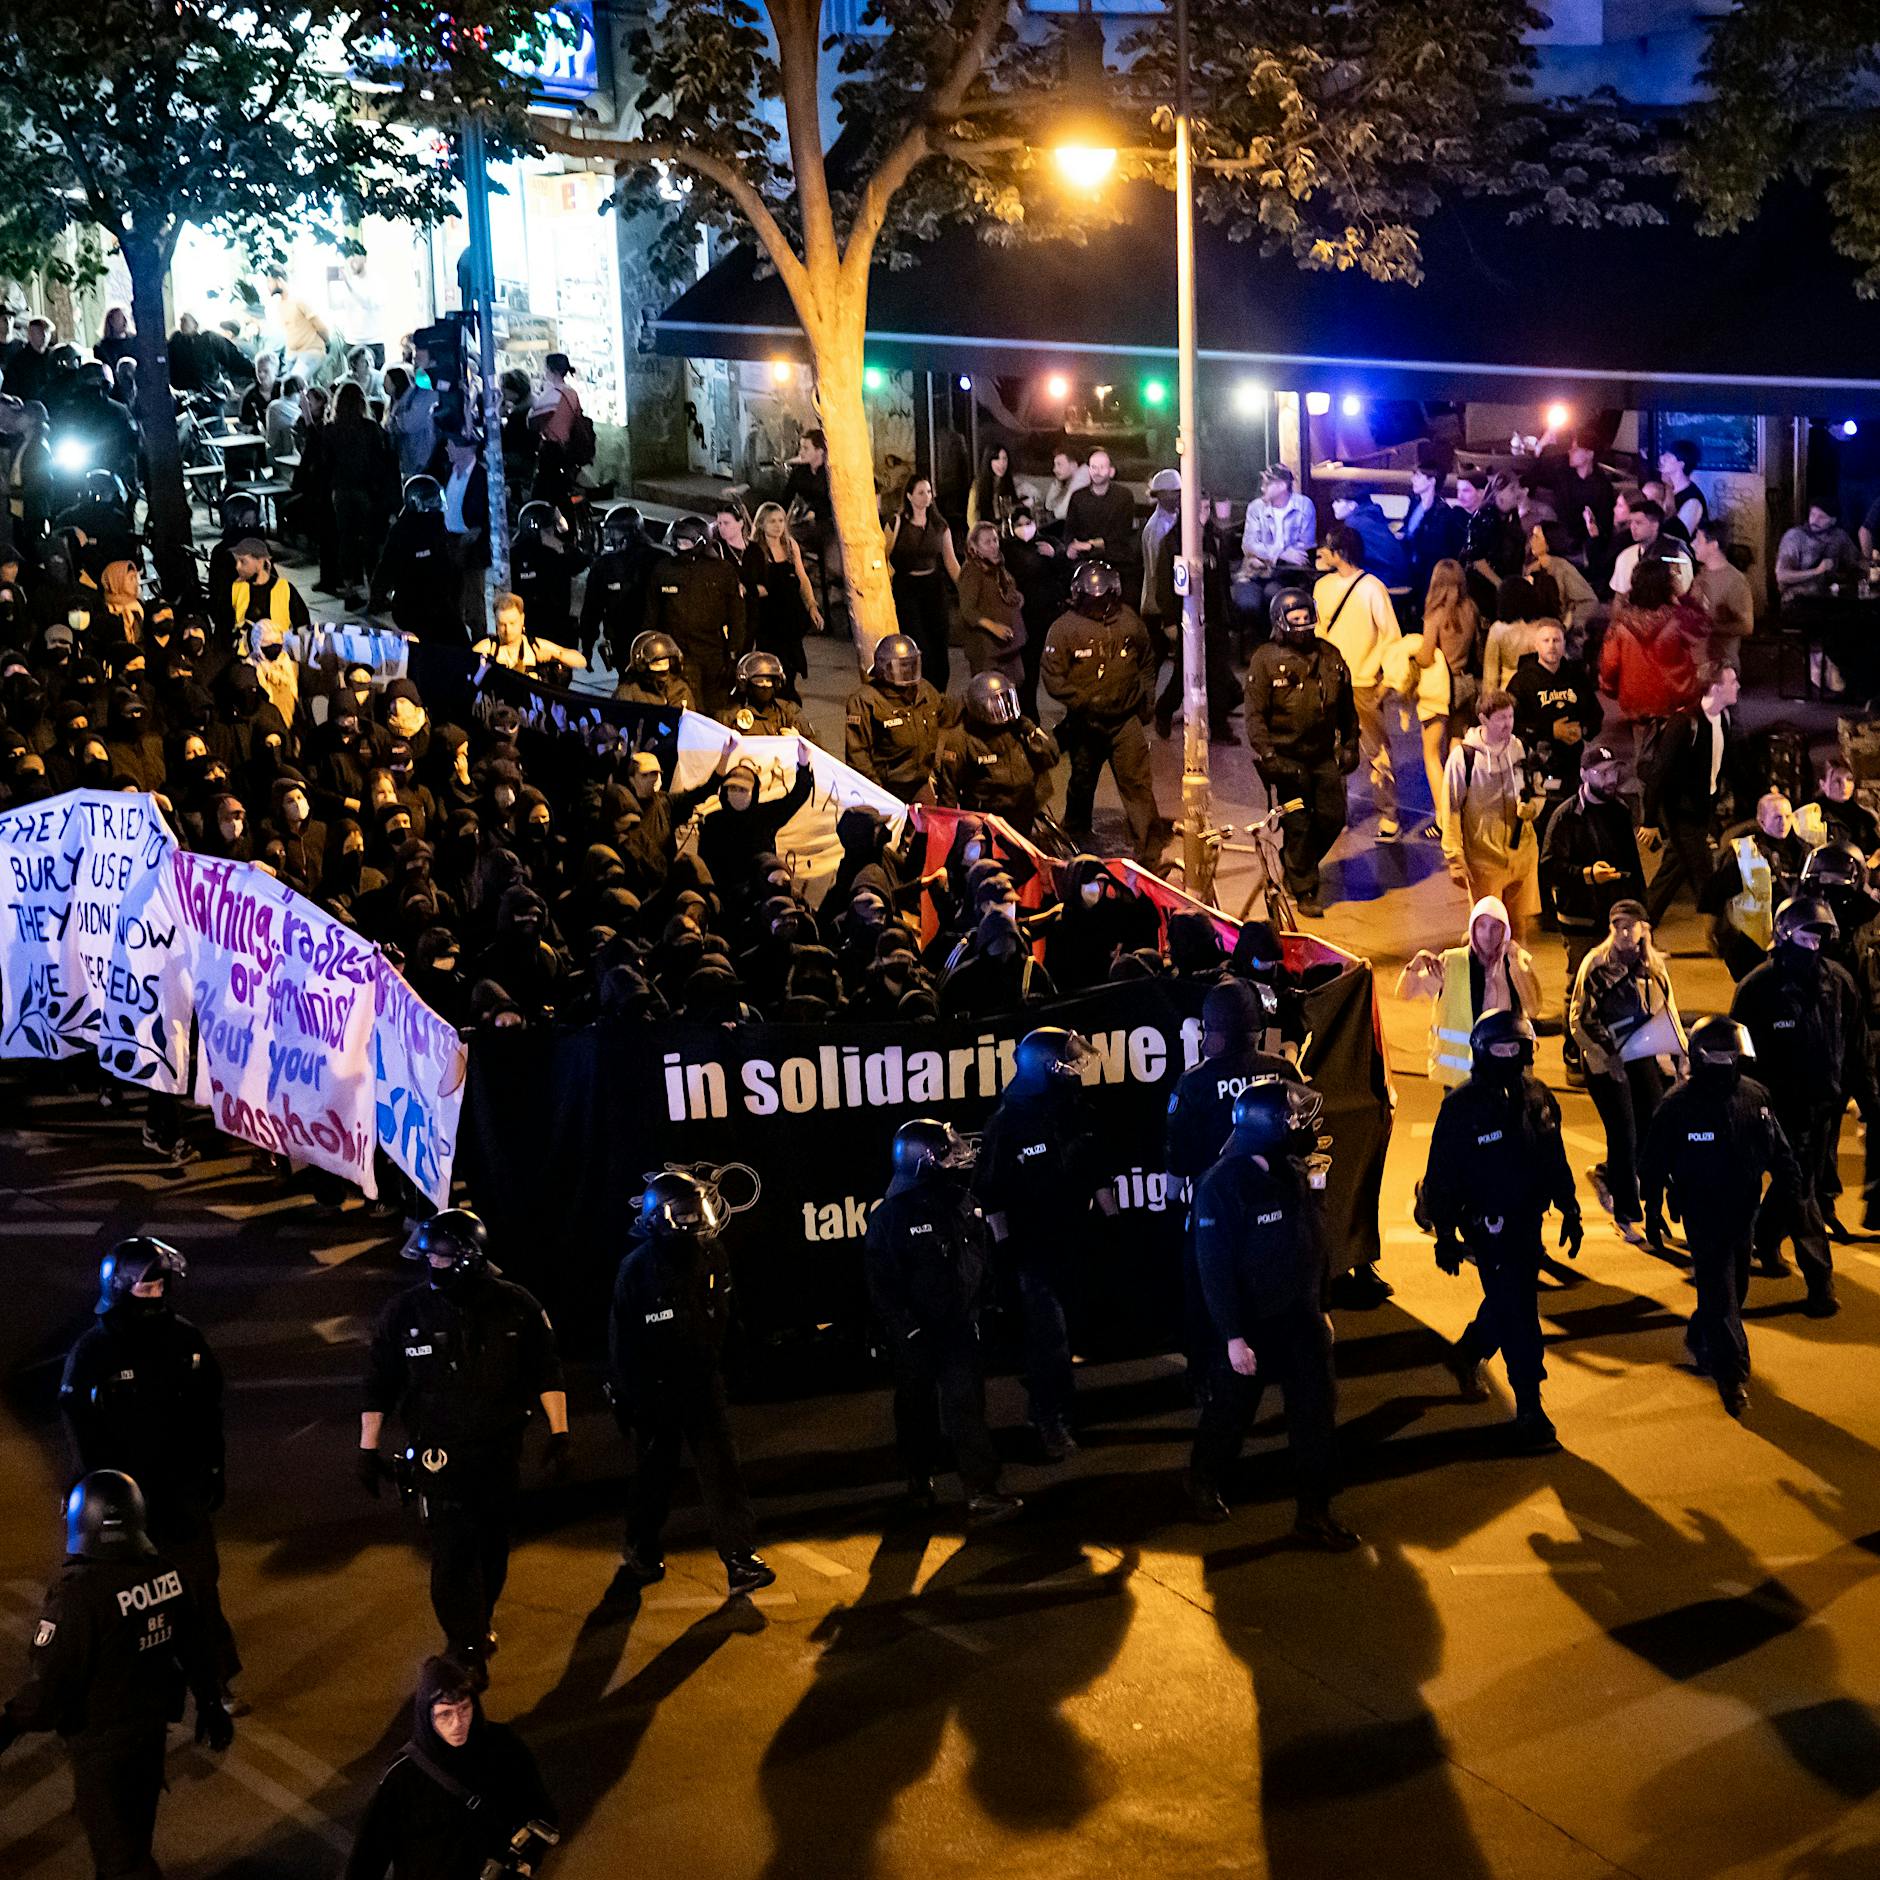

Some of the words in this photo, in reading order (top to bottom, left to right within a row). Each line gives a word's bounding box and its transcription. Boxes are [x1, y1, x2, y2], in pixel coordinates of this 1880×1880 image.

[10, 846, 84, 893] BURY
[8, 902, 72, 943] THEY
[174, 853, 274, 974] Nothing
[231, 964, 263, 1006] or
[267, 1040, 328, 1101] your
[663, 1052, 728, 1121] in
[741, 1033, 1018, 1116] solidarit
[1078, 1025, 1167, 1087] we
[1477, 1129, 1503, 1145] POLIZEI
[1687, 1131, 1715, 1141] POLIZEI
[802, 1196, 884, 1241] tak
[1257, 1209, 1283, 1225] POLIZEI
[645, 1308, 674, 1324] POLIZEI
[404, 1344, 433, 1357] POLIZEI
[116, 1570, 183, 1617] POLIZEI
